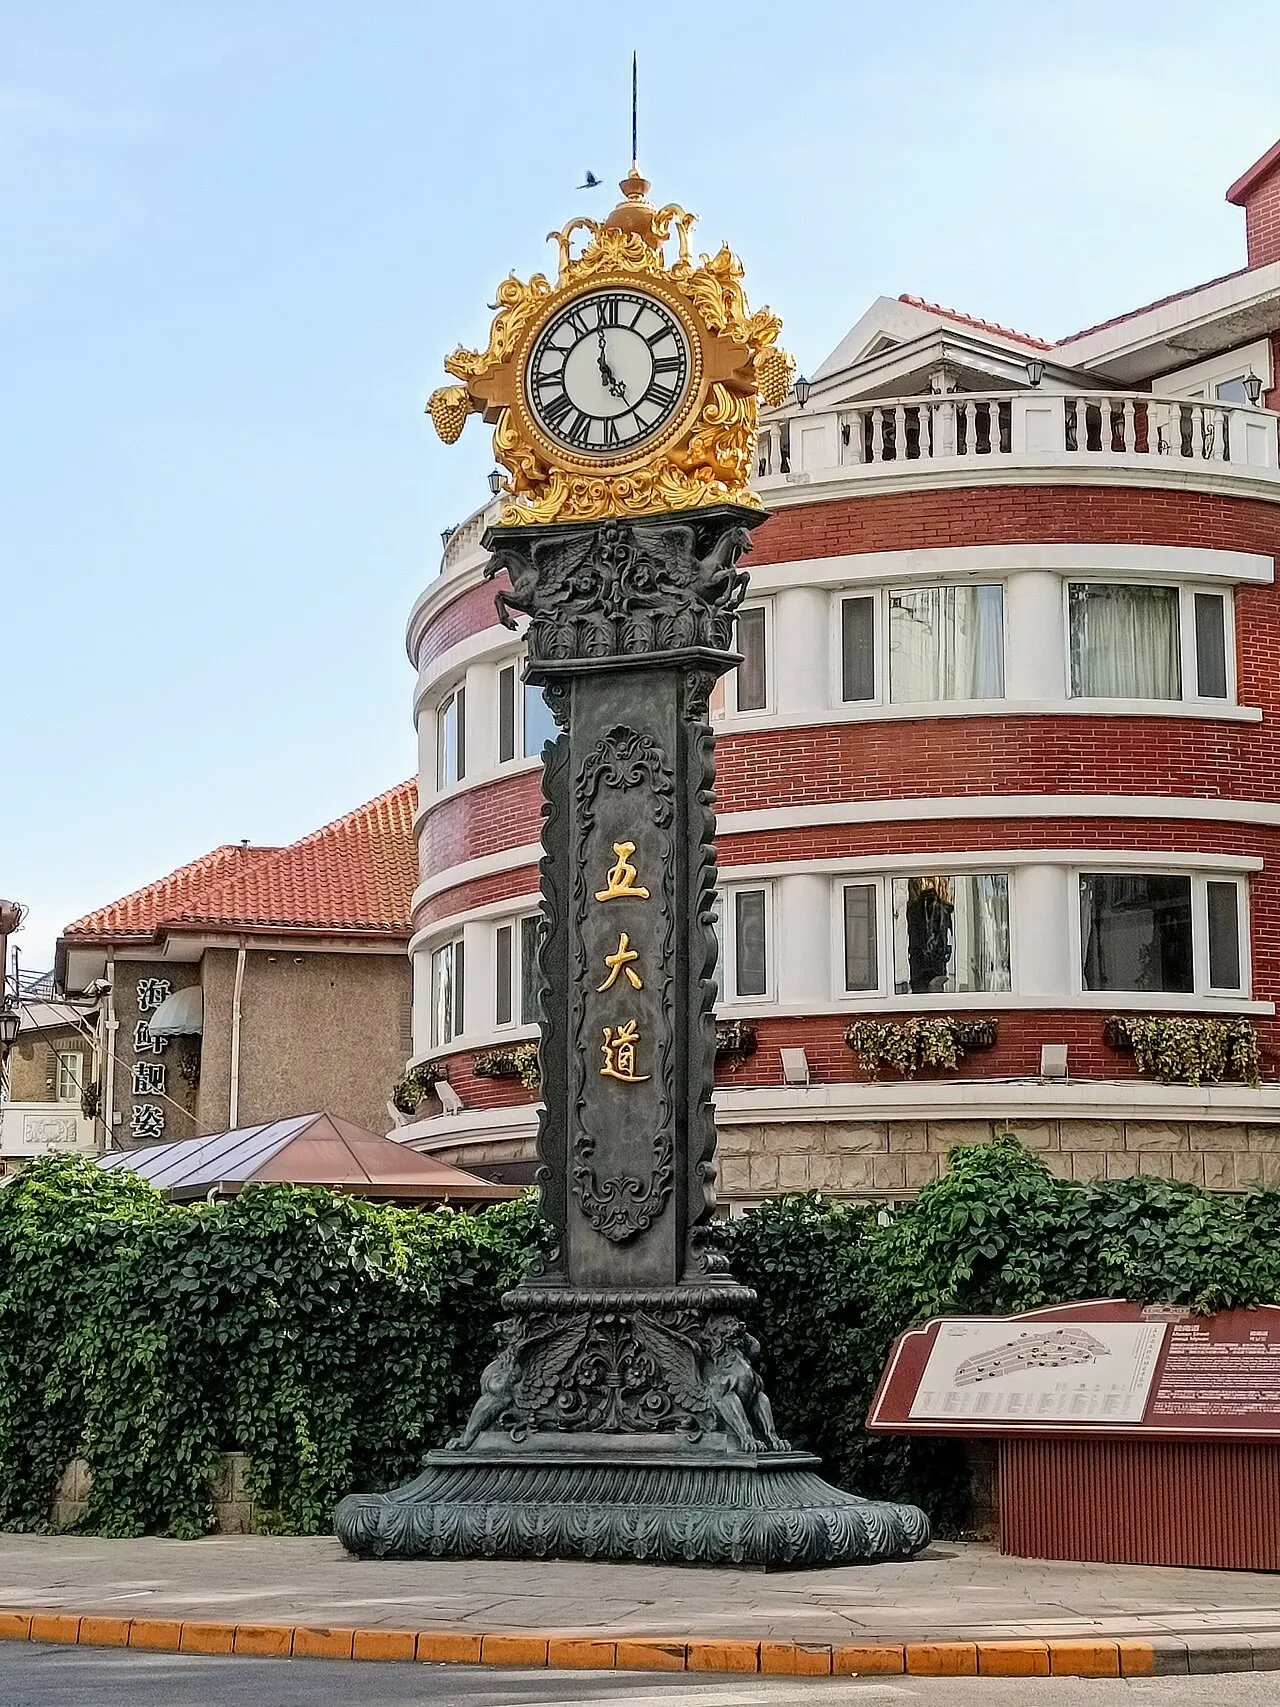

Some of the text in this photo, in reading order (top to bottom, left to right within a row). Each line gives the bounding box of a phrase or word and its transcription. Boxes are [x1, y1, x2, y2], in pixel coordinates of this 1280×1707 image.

[595, 299, 619, 325] XII
[563, 309, 589, 340] XI
[646, 325, 672, 346] II
[544, 340, 571, 357] X
[653, 356, 680, 374] III
[536, 367, 563, 388] IX
[567, 411, 592, 443] VII
[603, 417, 620, 444] VI
[632, 410, 651, 431] V
[594, 840, 652, 1083] 五大道
